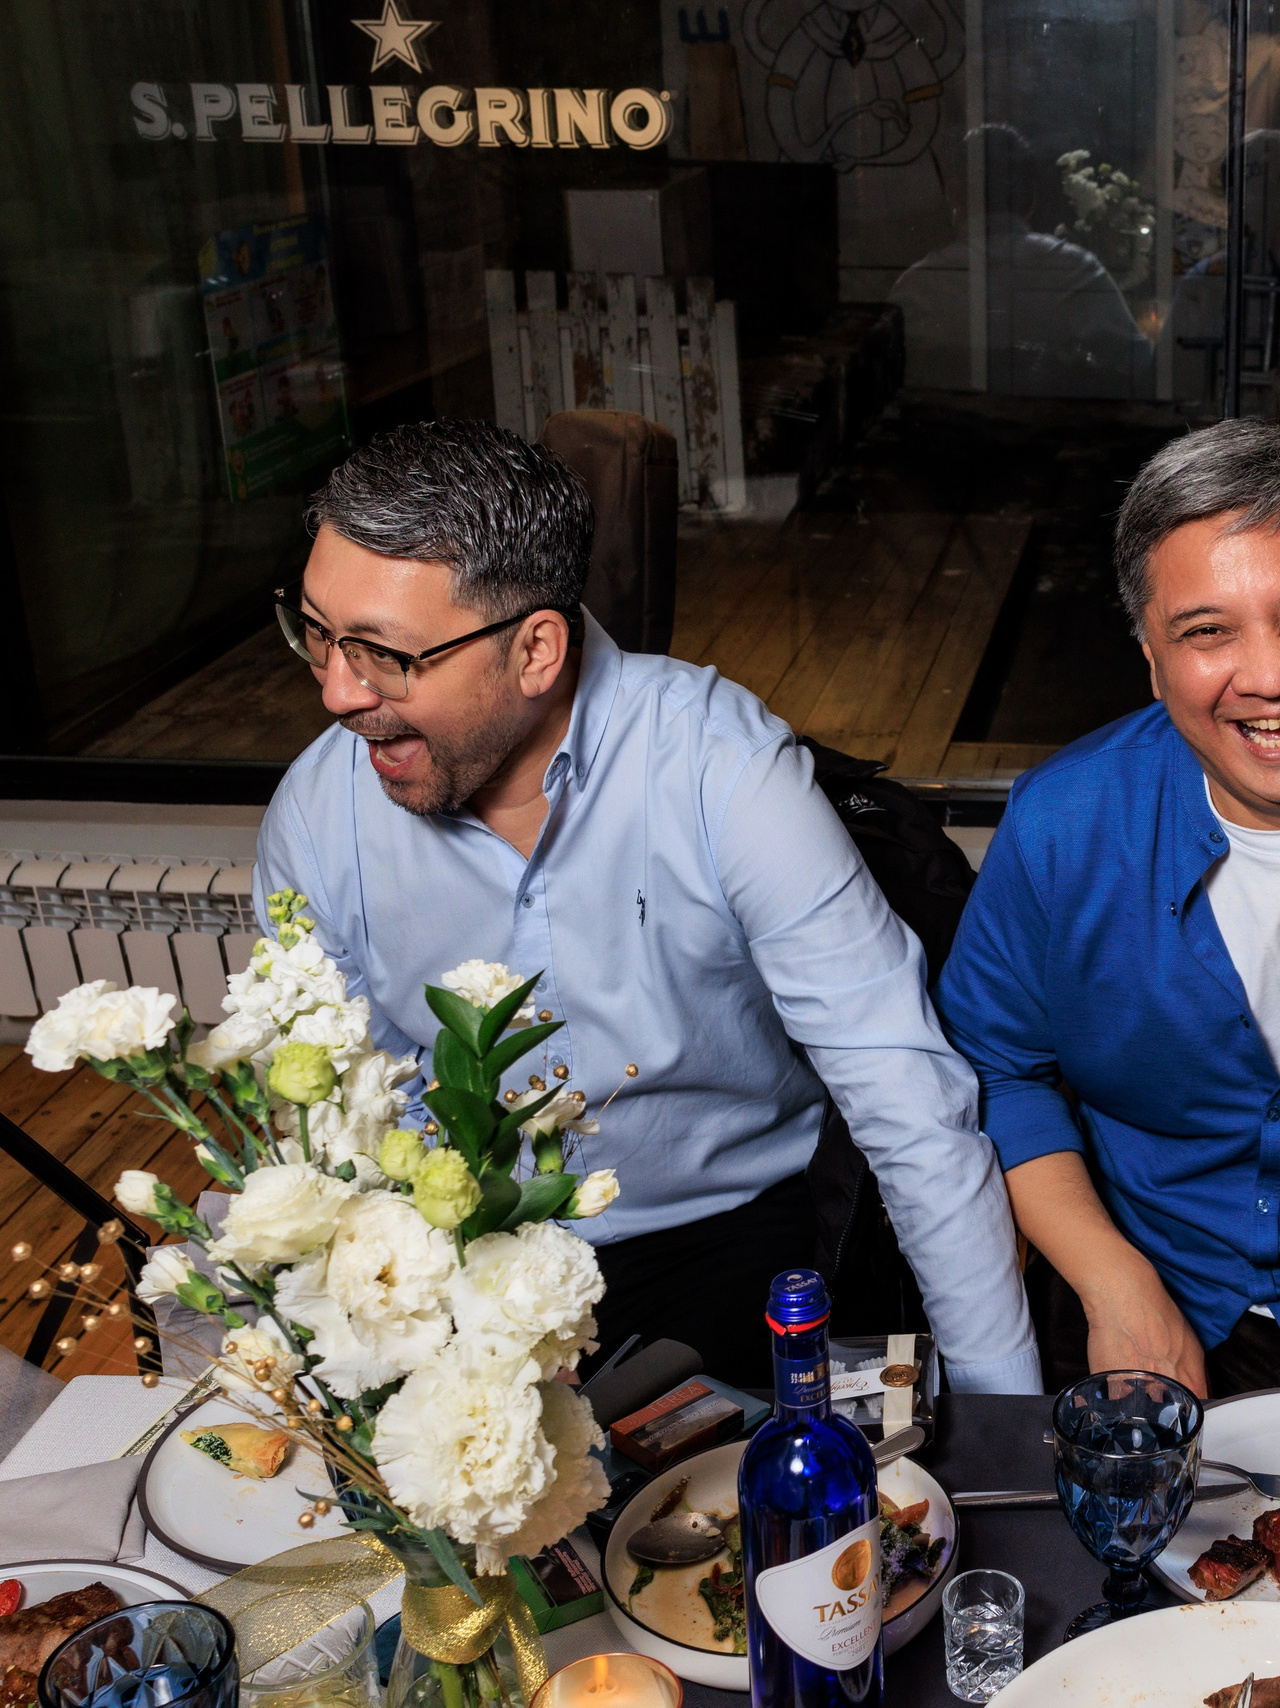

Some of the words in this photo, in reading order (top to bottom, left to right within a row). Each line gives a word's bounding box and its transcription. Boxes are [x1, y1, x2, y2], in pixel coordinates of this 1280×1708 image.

[784, 1276, 819, 1293] TASSAY
[647, 1385, 702, 1413] TEREA
[831, 1618, 877, 1652] EXCELLENT
